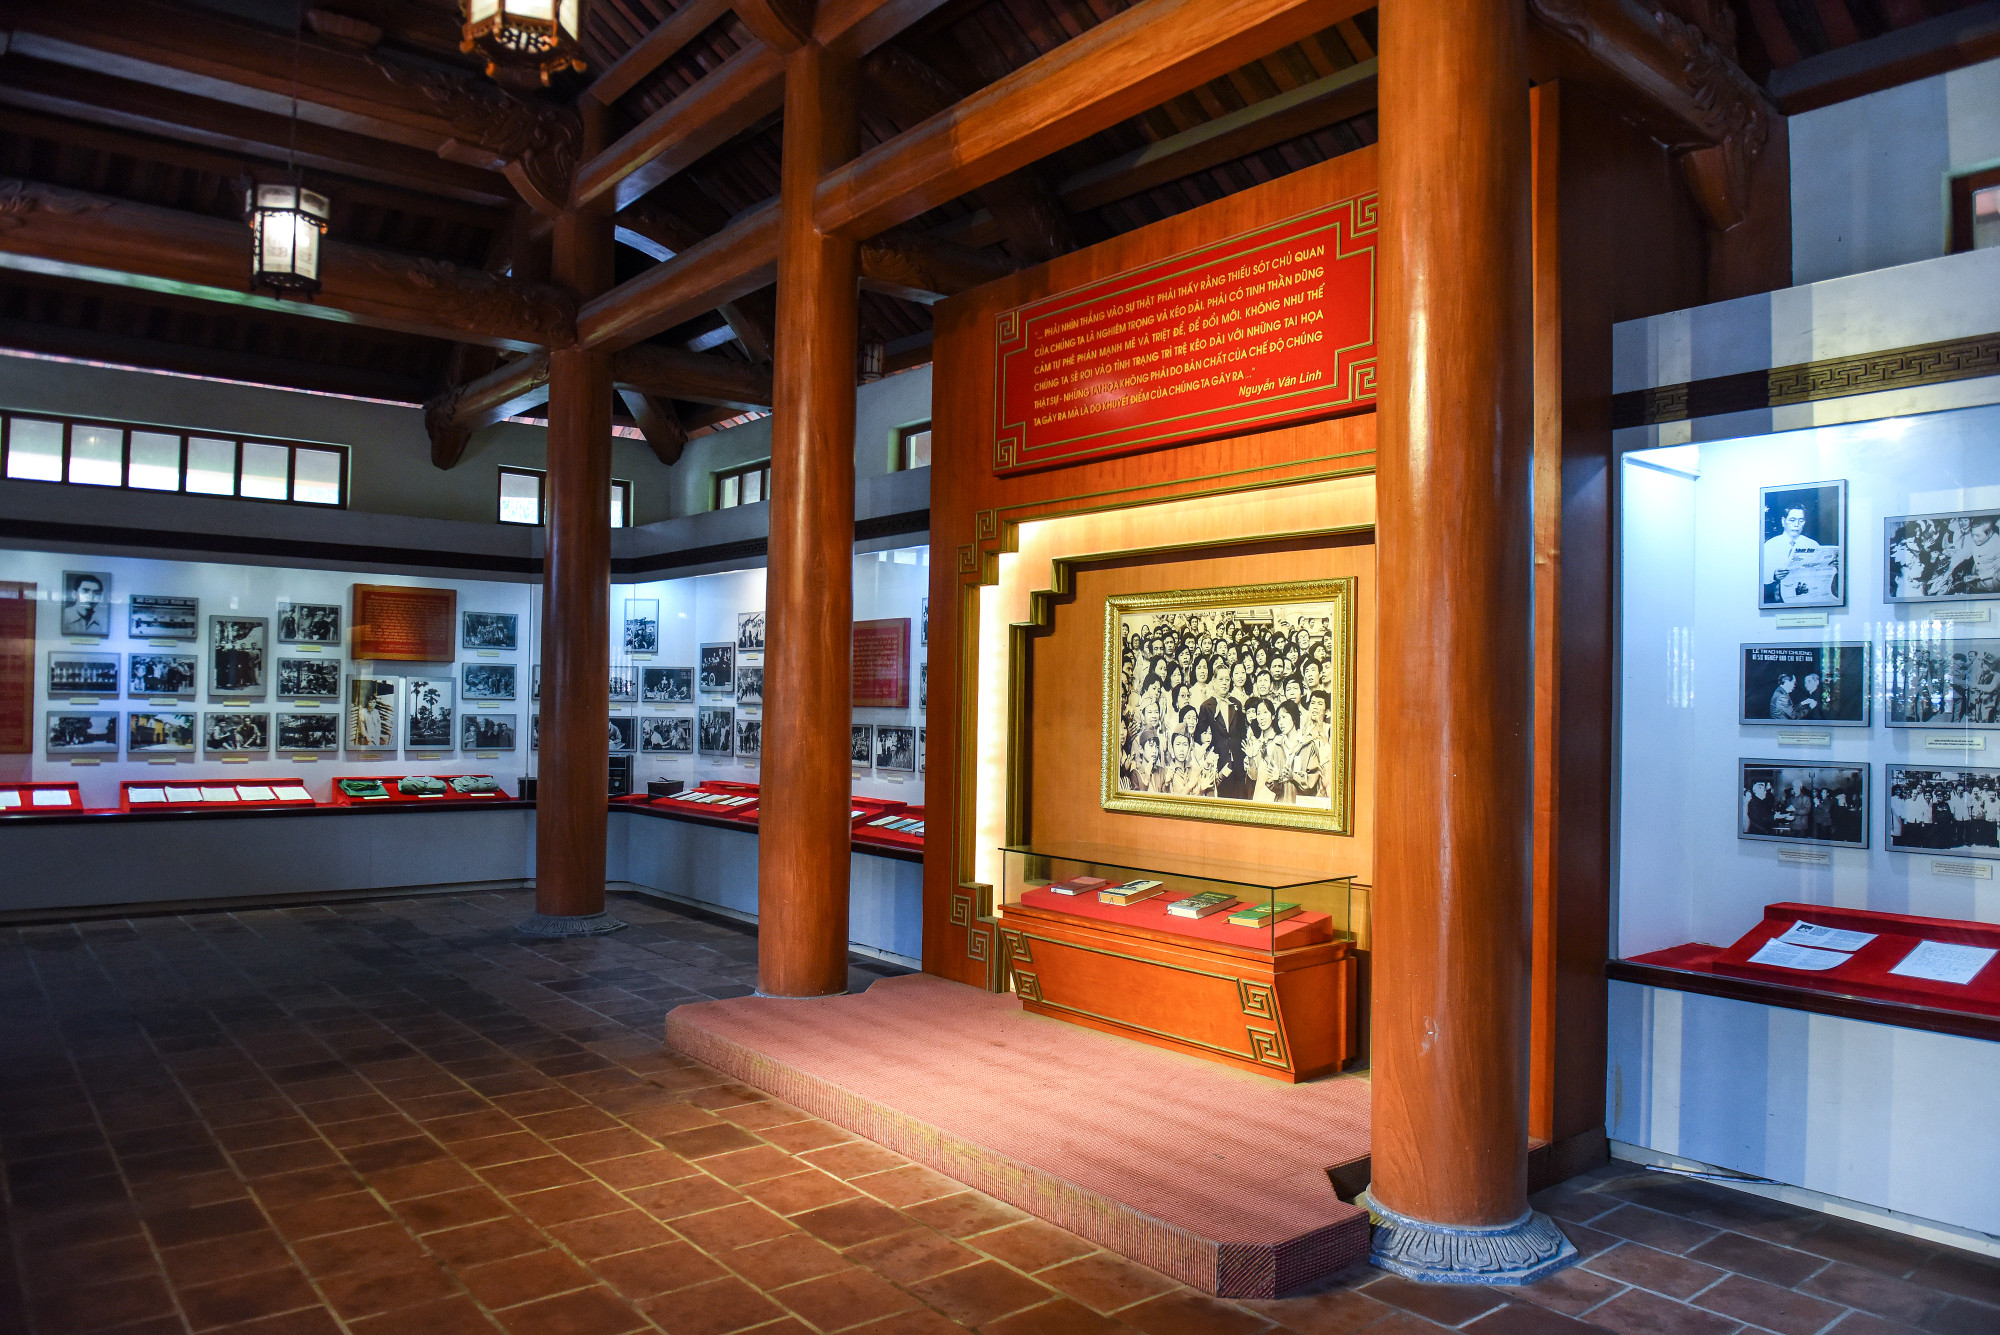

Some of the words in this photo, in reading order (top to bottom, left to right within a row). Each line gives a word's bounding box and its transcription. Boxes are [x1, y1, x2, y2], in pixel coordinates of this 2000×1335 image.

[1034, 344, 1050, 358] CỦA
[1050, 338, 1076, 353] CHÚNG
[1077, 336, 1086, 345] TA
[1086, 330, 1095, 343] LÀ
[1096, 323, 1126, 340] NGHIÊM
[1128, 315, 1154, 330] TRỌNG
[1156, 308, 1168, 322] VÀ
[1207, 292, 1227, 308] PHẢI
[1229, 286, 1244, 302] CÓ
[1246, 283, 1266, 297] TINH
[1267, 274, 1292, 291] THẦN
[1294, 266, 1324, 284] DŨNG
[1034, 360, 1052, 374] CẢM
[1053, 359, 1061, 370] TỰ
[1062, 354, 1074, 366] PHÊ
[1077, 349, 1097, 363] PHÁN
[1099, 342, 1122, 358] MẠNH
[1124, 336, 1136, 350] MẼ
[1138, 332, 1150, 346] VÀ
[1152, 328, 1171, 342] TRIỆT
[1188, 316, 1200, 333] ĐỂ
[1202, 312, 1219, 329] ĐỔI
[1222, 308, 1242, 324] MỚI.
[1245, 301, 1280, 318] KHÔNG
[1284, 292, 1304, 308] NHƯ
[1306, 282, 1326, 301] THẾ
[1044, 322, 1060, 337] PHẢI
[1061, 318, 1079, 332] NHÌN
[1106, 305, 1124, 318] VÀO
[1125, 301, 1135, 314] SỰ
[1136, 295, 1155, 310] THẬT
[1157, 287, 1176, 304] PHẢI
[1178, 280, 1199, 297] THẤY
[1228, 264, 1250, 282] THIẾU
[1252, 260, 1270, 275] SÓT
[1272, 250, 1292, 269] CHỦ
[1294, 244, 1325, 262] QUAN
[1034, 378, 1060, 392] CHÚNG
[1061, 376, 1069, 384] TA
[1070, 370, 1078, 382] SẼ
[1094, 363, 1112, 376] VÀO
[1114, 358, 1130, 372] TÌNH
[1132, 352, 1160, 367] TRẠNG
[1161, 344, 1172, 360] TRÌ
[1174, 342, 1187, 356] TRỆ
[1210, 332, 1224, 348] DÀI
[1228, 327, 1244, 342] VỚI
[1246, 320, 1282, 338] NHỮNG
[1284, 316, 1298, 328] TAI
[1300, 310, 1324, 324] HỌA
[1064, 388, 1090, 402] NHỮNG
[1091, 384, 1101, 396] TAI
[1120, 374, 1149, 389] KHÔNG
[1150, 366, 1169, 381] PHẢI
[1170, 365, 1183, 376] DO
[1184, 358, 1202, 373] BẢN
[1203, 351, 1226, 368] CHẤT
[1228, 347, 1248, 362] CỦA
[1248, 340, 1268, 356] CHẾ
[1269, 338, 1284, 352] ĐỘ
[1286, 331, 1323, 348] CHÚNG
[1238, 378, 1275, 398] Nguyễn
[1278, 376, 1297, 388] Văn
[1300, 370, 1322, 384] Linh
[1034, 418, 1042, 426] TA
[1042, 413, 1056, 424] GÂY
[1058, 412, 1067, 421] RA
[1068, 406, 1080, 418] MÀ
[1081, 404, 1089, 416] LÀ
[1090, 404, 1102, 414] DO
[1102, 394, 1130, 410] KHUYẾT
[1150, 386, 1168, 400] CỦA
[1168, 380, 1200, 396] CHÚNG
[1200, 378, 1210, 388] TA
[1212, 372, 1231, 386] GÂY
